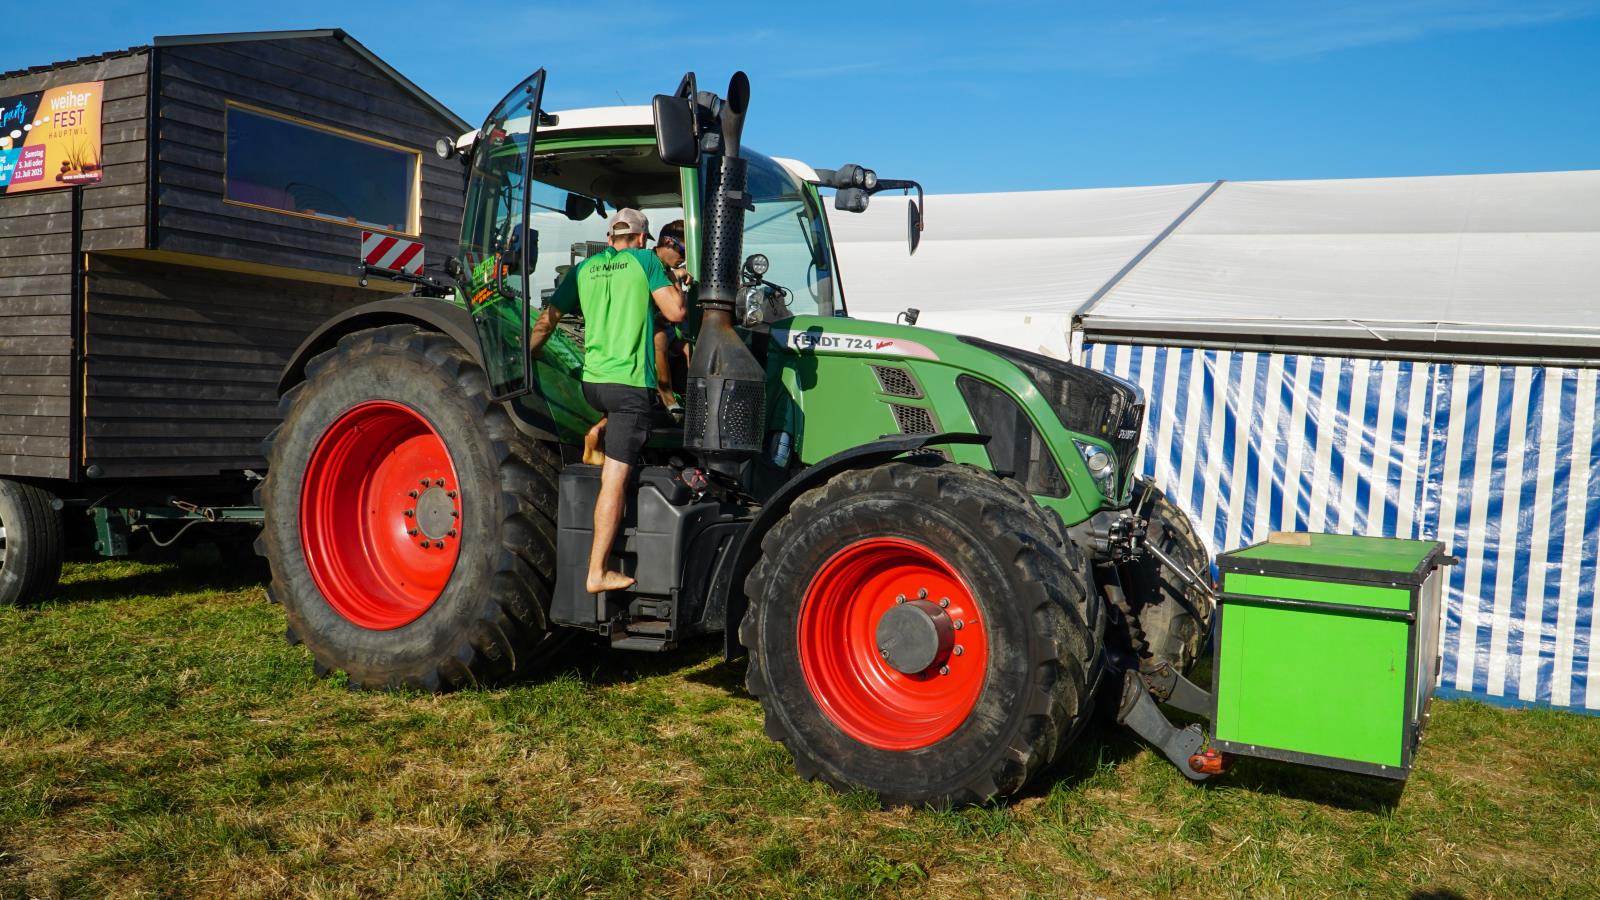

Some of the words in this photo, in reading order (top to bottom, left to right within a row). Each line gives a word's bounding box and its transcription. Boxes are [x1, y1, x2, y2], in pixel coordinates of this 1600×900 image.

[51, 91, 92, 110] weiher
[4, 101, 28, 127] party
[53, 109, 85, 129] FEST
[48, 128, 88, 139] HAUPTWIL
[792, 334, 841, 347] FENDT
[845, 338, 873, 350] 724
